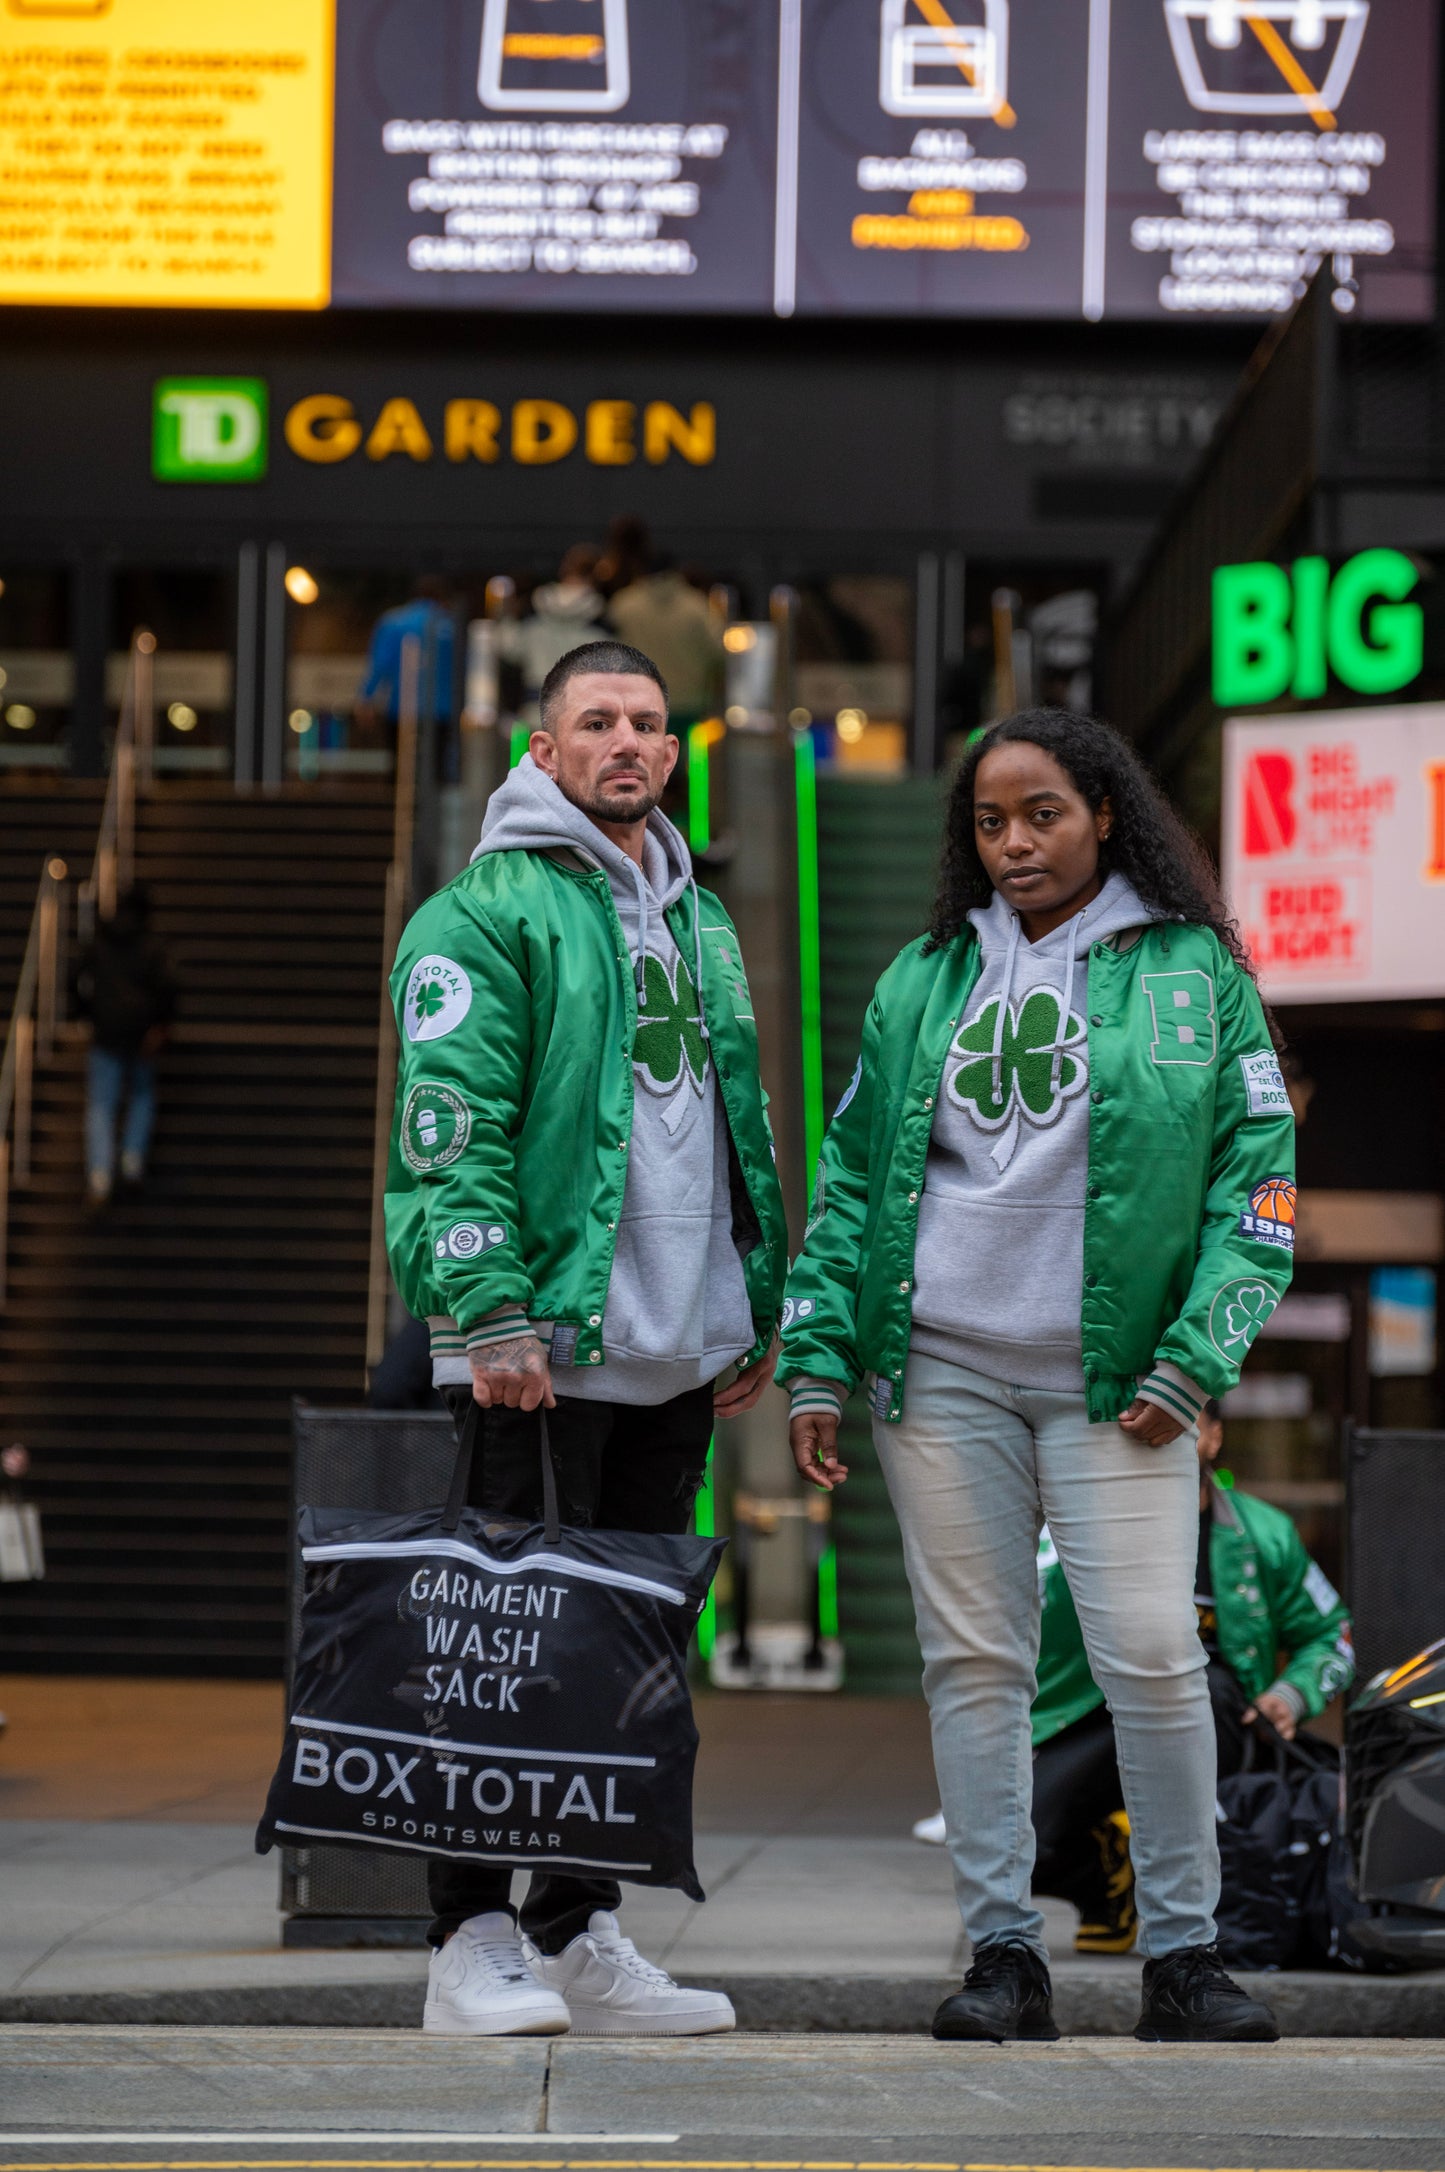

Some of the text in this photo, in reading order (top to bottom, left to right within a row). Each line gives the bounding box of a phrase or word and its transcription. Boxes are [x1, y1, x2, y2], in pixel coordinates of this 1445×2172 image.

[158, 391, 716, 466] TD GARDEN
[1211, 547, 1424, 708] BIG
[1264, 880, 1344, 920] BUD
[408, 966, 463, 1005] BOX TOTAL
[1141, 969, 1217, 1067] B
[1242, 1215, 1295, 1241] 198
[409, 1569, 569, 1620] GARMENT
[425, 1616, 541, 1667] WASH
[423, 1664, 523, 1713] SACK
[292, 1739, 421, 1804] BOX
[436, 1762, 637, 1824] TOTAL
[362, 1811, 562, 1848] SPORTSWEAR
